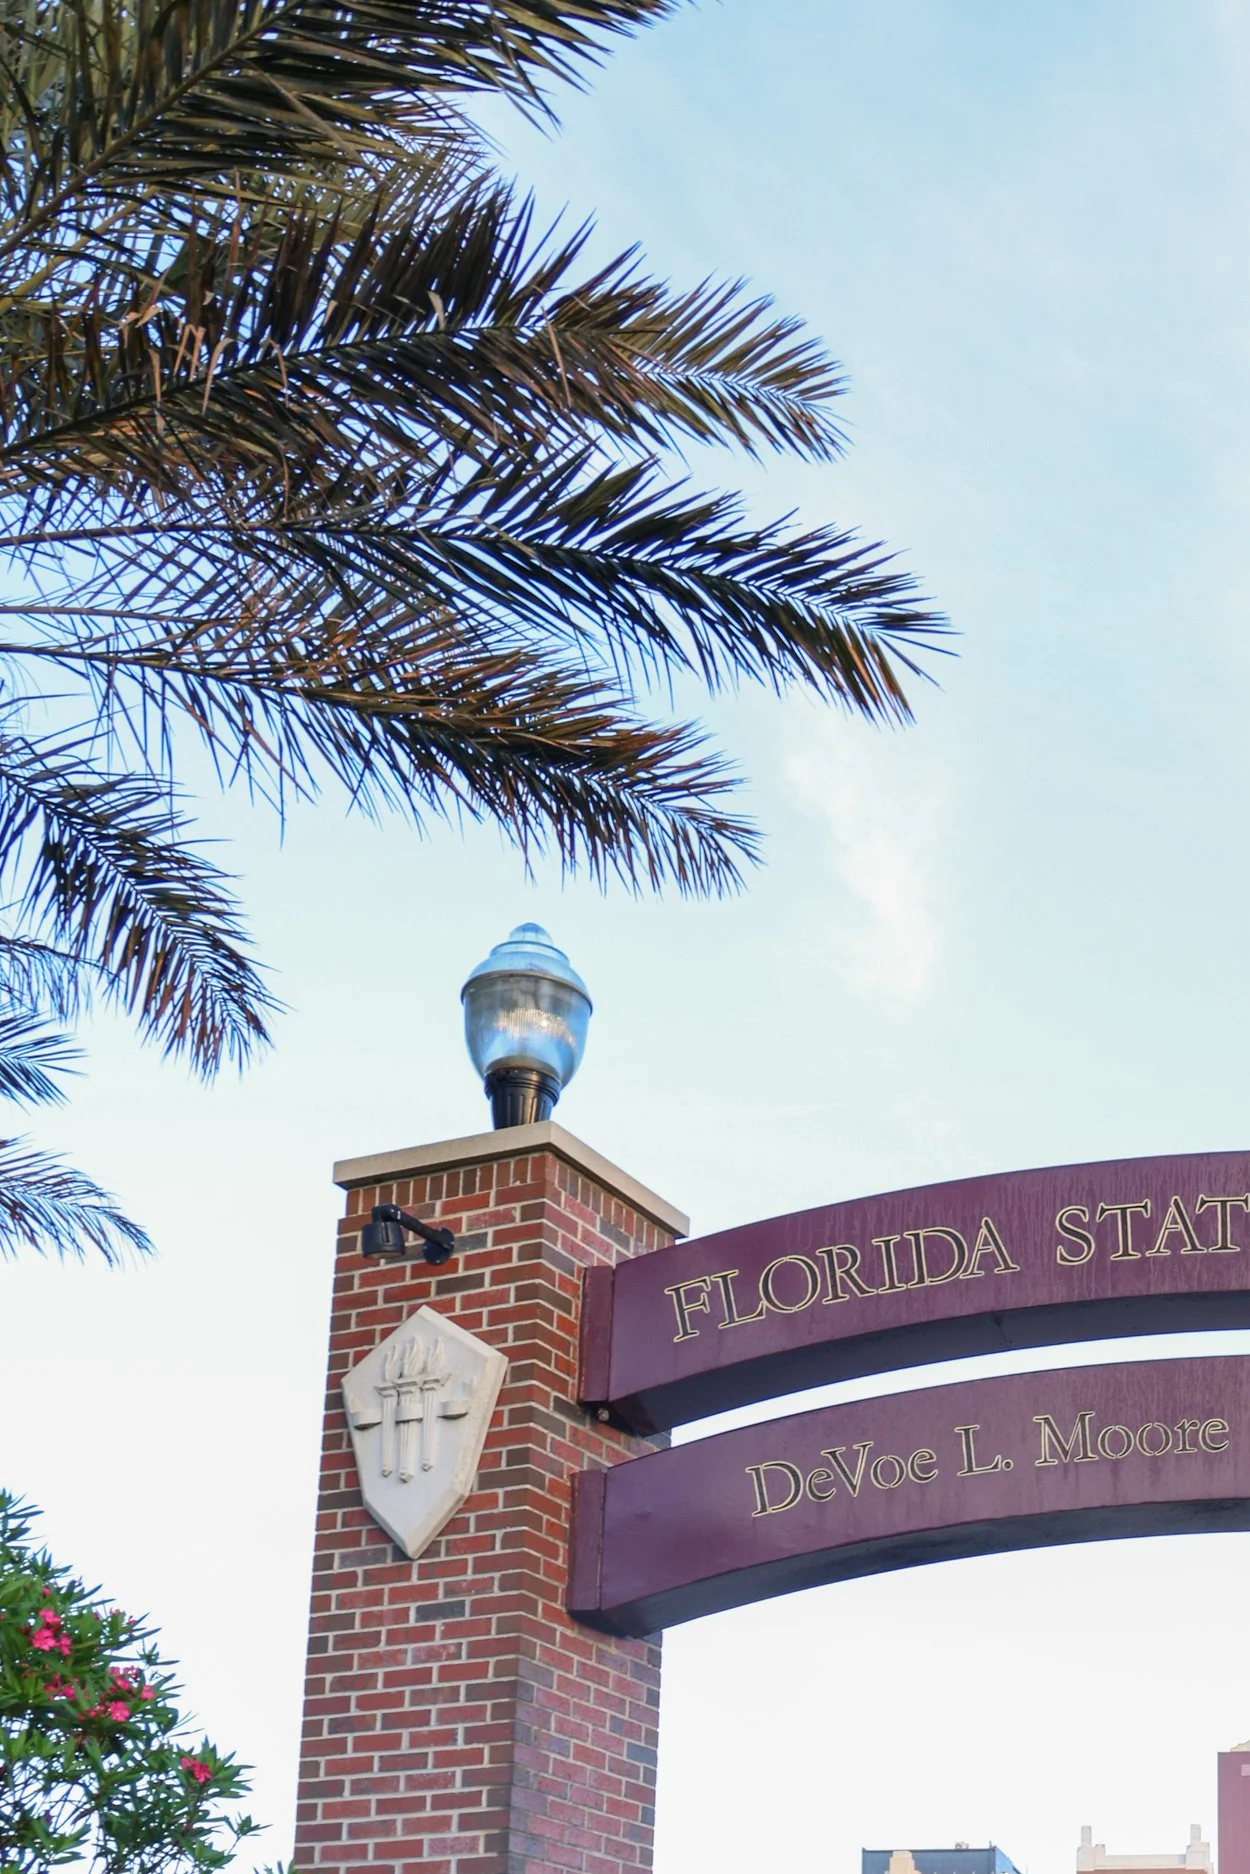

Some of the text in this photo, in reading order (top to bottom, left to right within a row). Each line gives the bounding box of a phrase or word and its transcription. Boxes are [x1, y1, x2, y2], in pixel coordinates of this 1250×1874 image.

[664, 1216, 1020, 1343] FLORIDA
[744, 1440, 938, 1518] DeVoe
[954, 1424, 1015, 1477] L.
[1033, 1410, 1230, 1467] Moore
